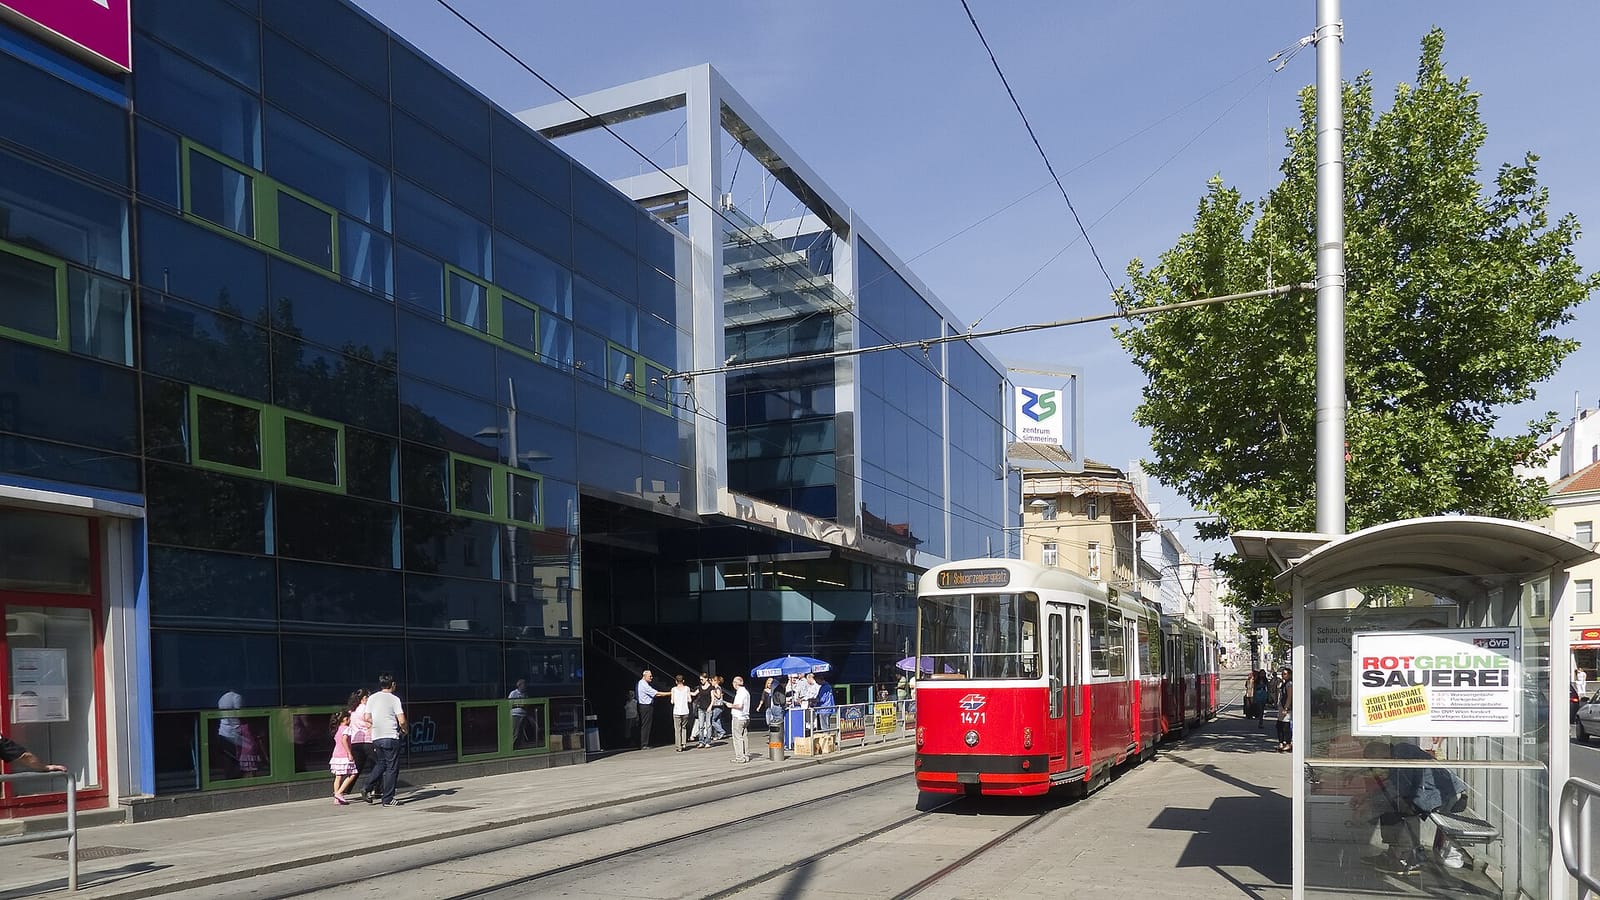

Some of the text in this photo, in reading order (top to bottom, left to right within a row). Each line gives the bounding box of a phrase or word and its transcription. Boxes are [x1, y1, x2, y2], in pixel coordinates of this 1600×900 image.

[1022, 434, 1057, 443] simmering
[940, 572, 951, 586] 71
[1317, 627, 1340, 635] Schau,
[1488, 638, 1509, 647] ÖVP
[1362, 651, 1510, 670] ROTGRÜNE
[1362, 670, 1509, 687] SAUEREI
[1365, 687, 1422, 706] JEDER HAUSHALT
[1388, 699, 1404, 709] PRO
[1405, 695, 1425, 706] JAHR
[960, 712, 986, 724] 1471
[1368, 703, 1427, 722] 200 EURO MEHR!
